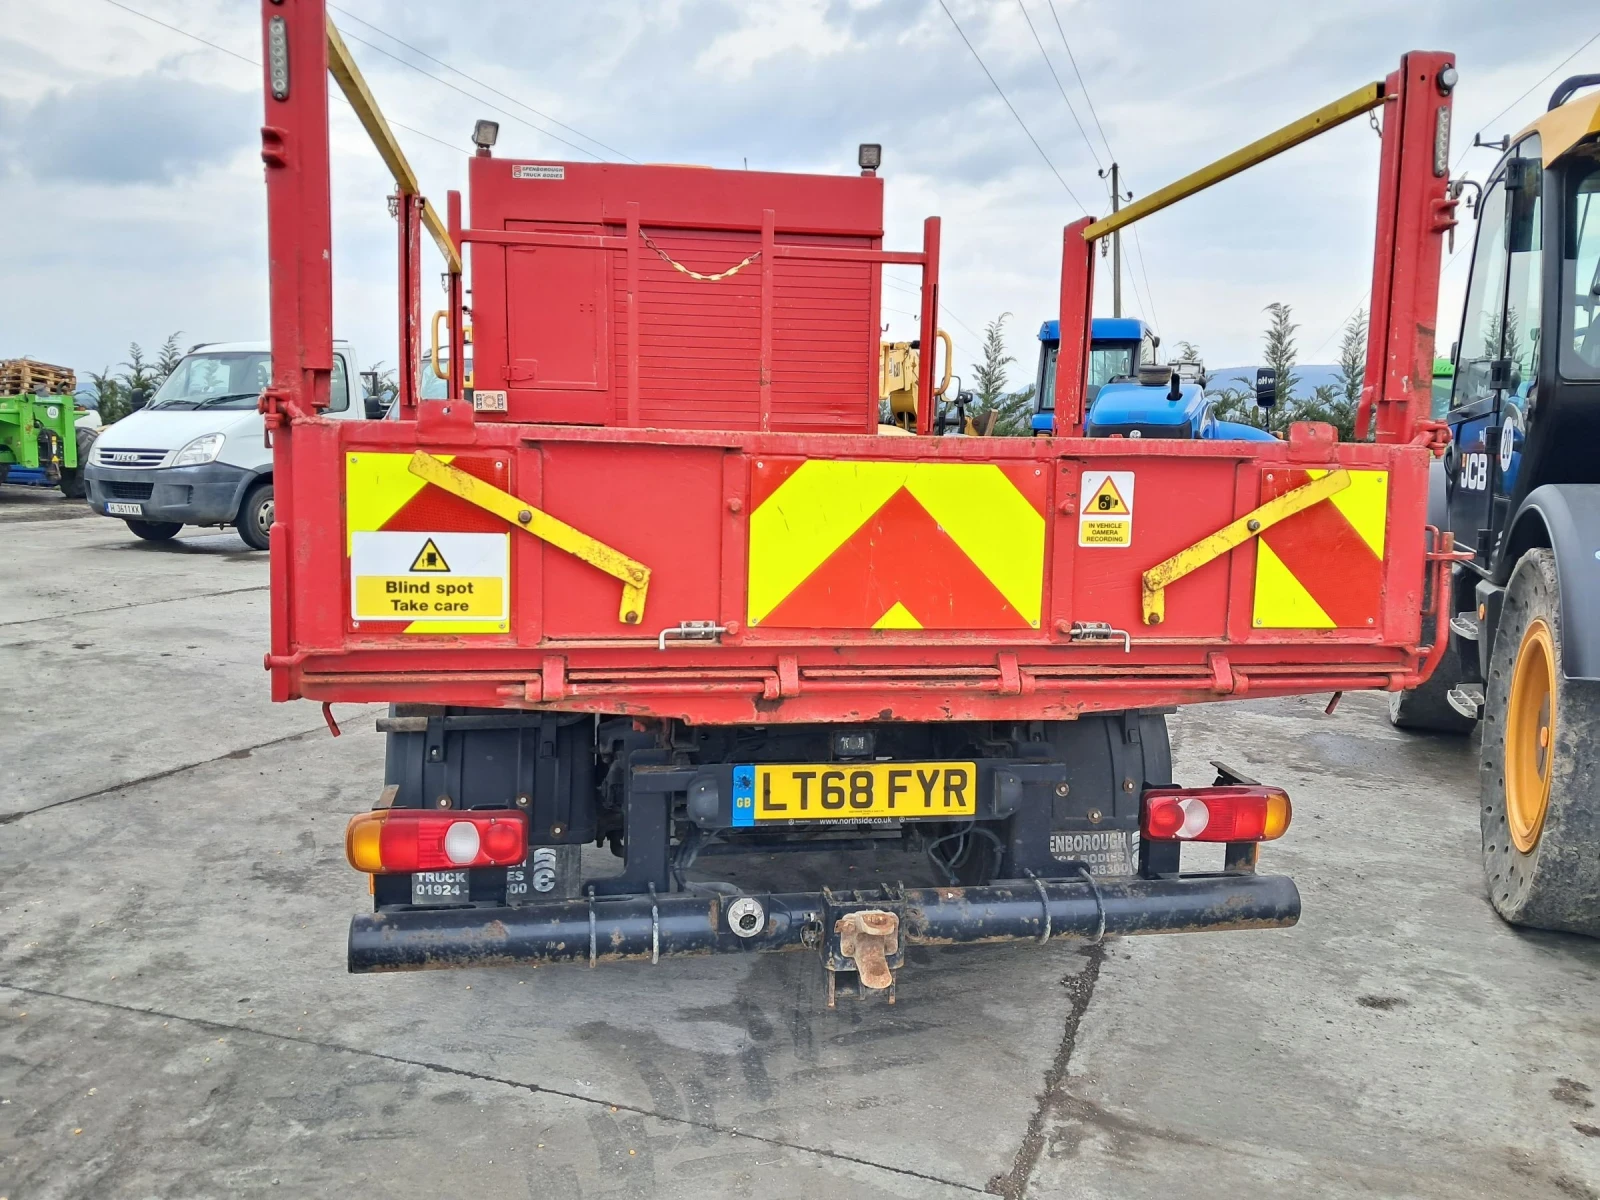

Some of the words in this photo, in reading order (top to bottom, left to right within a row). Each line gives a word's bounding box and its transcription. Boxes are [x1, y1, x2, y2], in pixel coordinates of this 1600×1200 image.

[1502, 427, 1511, 460] 20
[112, 453, 139, 462] IVECO
[1460, 453, 1487, 490] JCB
[385, 580, 430, 594] Blind
[435, 581, 474, 596] spot
[390, 599, 429, 611] Take
[433, 602, 469, 611] care
[762, 770, 874, 811] LT68
[887, 769, 967, 809] FYR
[736, 797, 752, 808] GB
[819, 816, 892, 825] www.northside.co.uk
[1089, 863, 1129, 875] 38300
[416, 872, 466, 883] TRUCK
[416, 884, 460, 896] 01924
